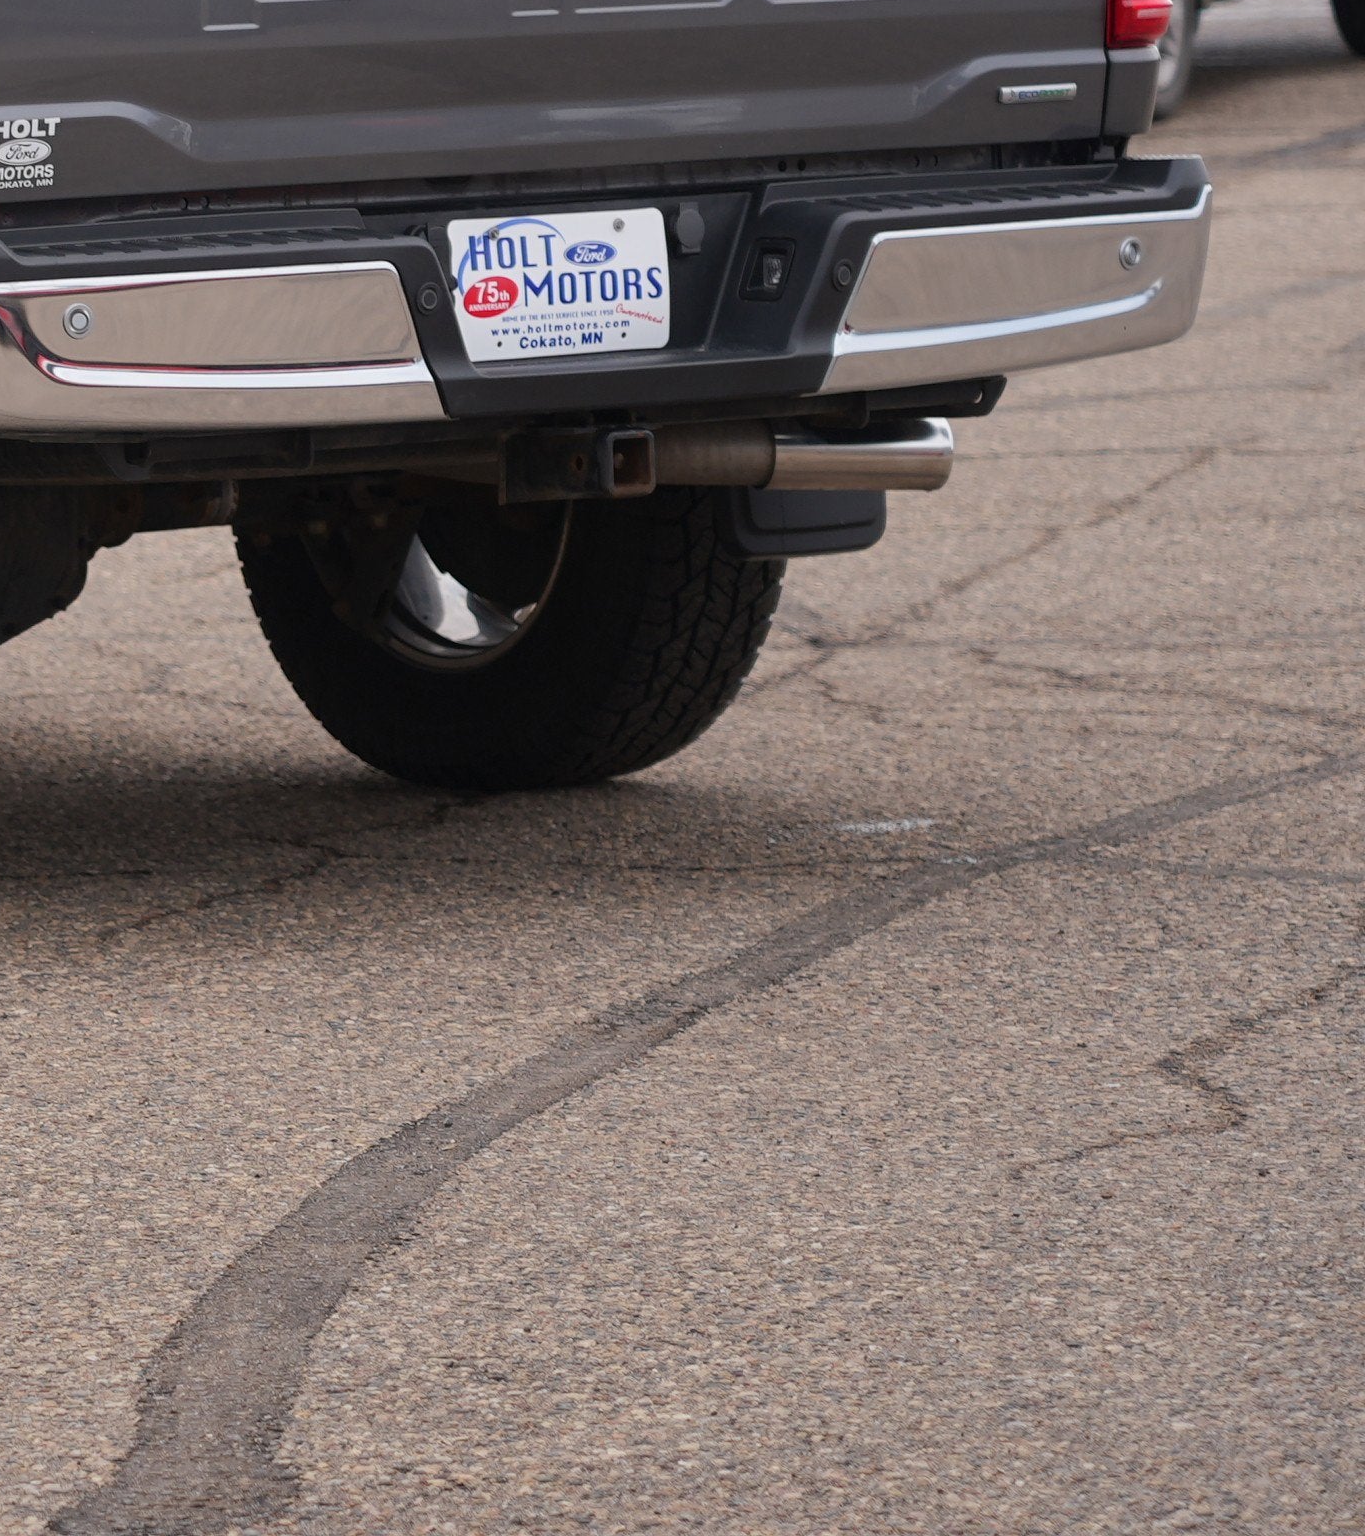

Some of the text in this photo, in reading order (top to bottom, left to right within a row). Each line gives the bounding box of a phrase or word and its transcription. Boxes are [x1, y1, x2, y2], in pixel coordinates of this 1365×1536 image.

[5, 143, 40, 160] Ford
[36, 178, 54, 187] MN
[469, 234, 557, 271] HOLT
[573, 244, 608, 264] Ford
[474, 280, 511, 304] 75th
[523, 267, 663, 307] MOTORS
[581, 309, 597, 317] SINCE
[491, 320, 630, 336] www.holtmotors.com
[519, 332, 603, 349] Cokato, MN
